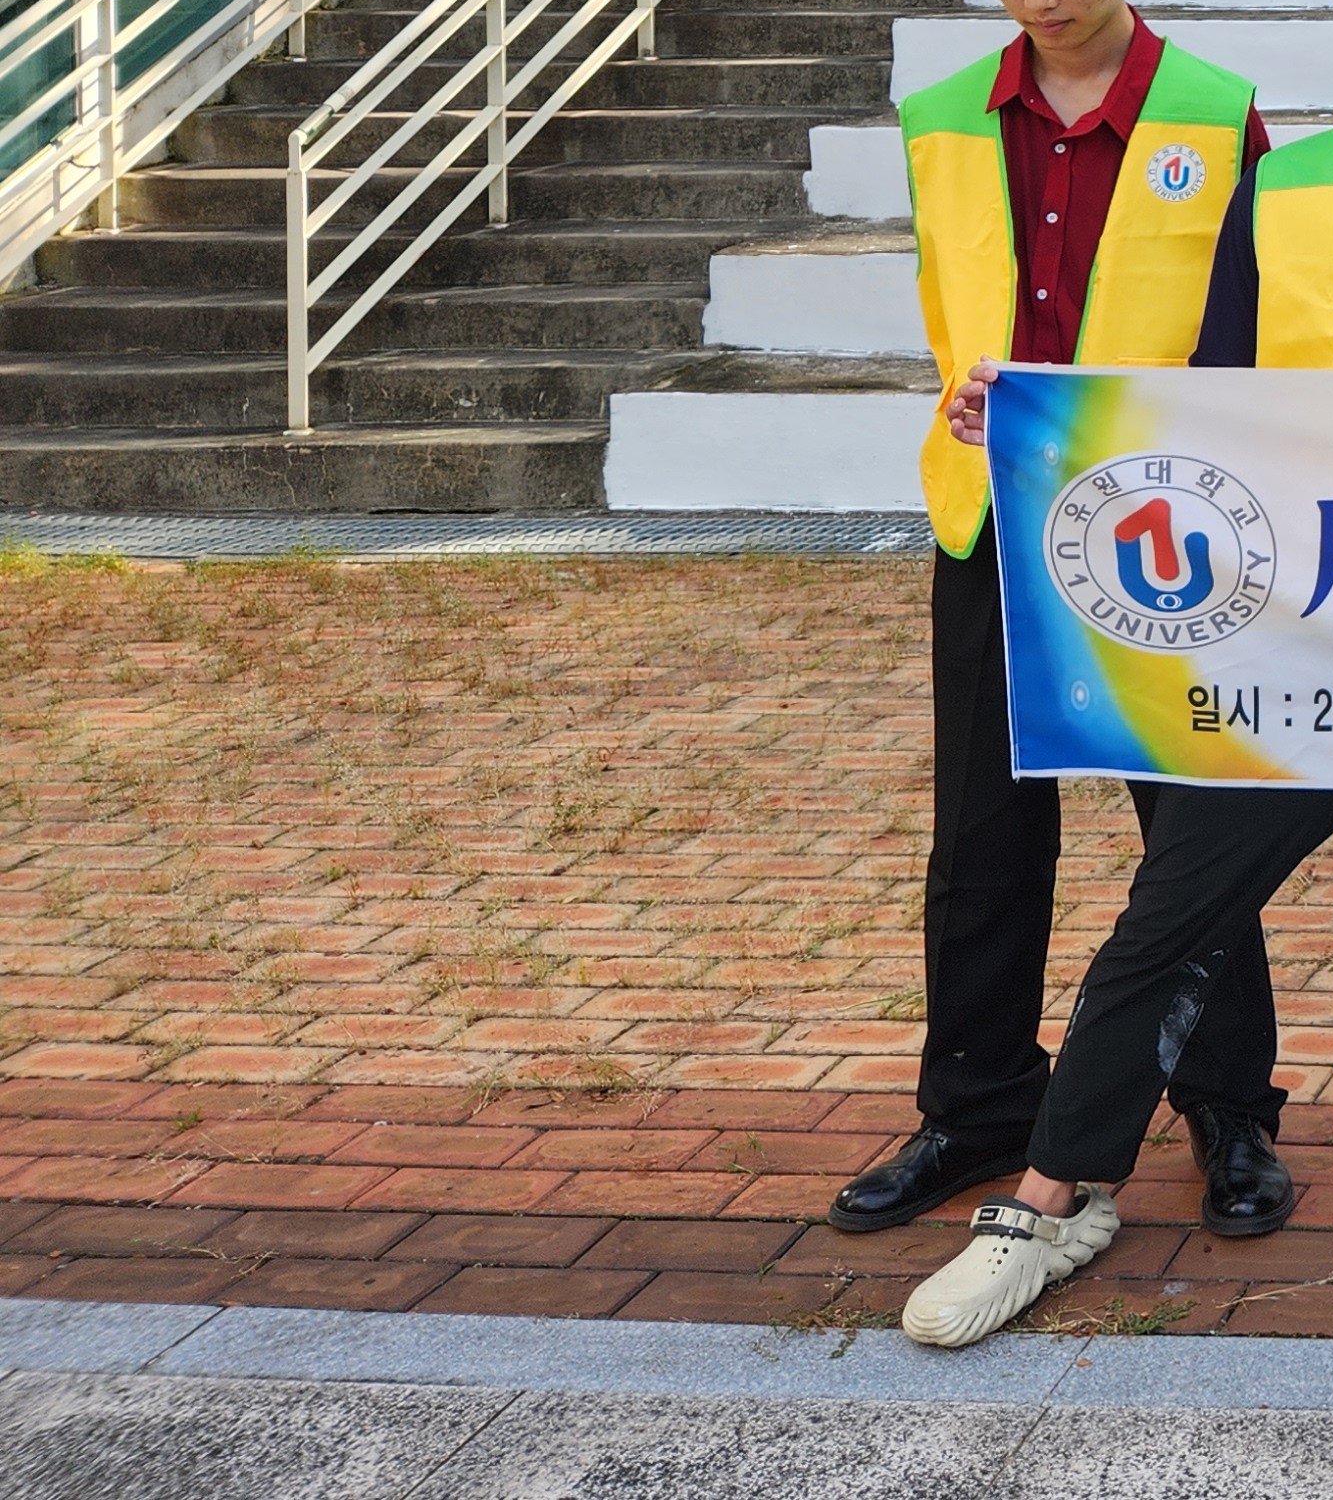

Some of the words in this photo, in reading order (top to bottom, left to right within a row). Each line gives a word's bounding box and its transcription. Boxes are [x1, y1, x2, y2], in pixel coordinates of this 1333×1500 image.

[1154, 172, 1205, 200] UNIVERSITY
[1063, 458, 1261, 530] 유원대학교
[1090, 549, 1271, 644] UNIVERSITY
[1187, 685, 1261, 734] 일시
